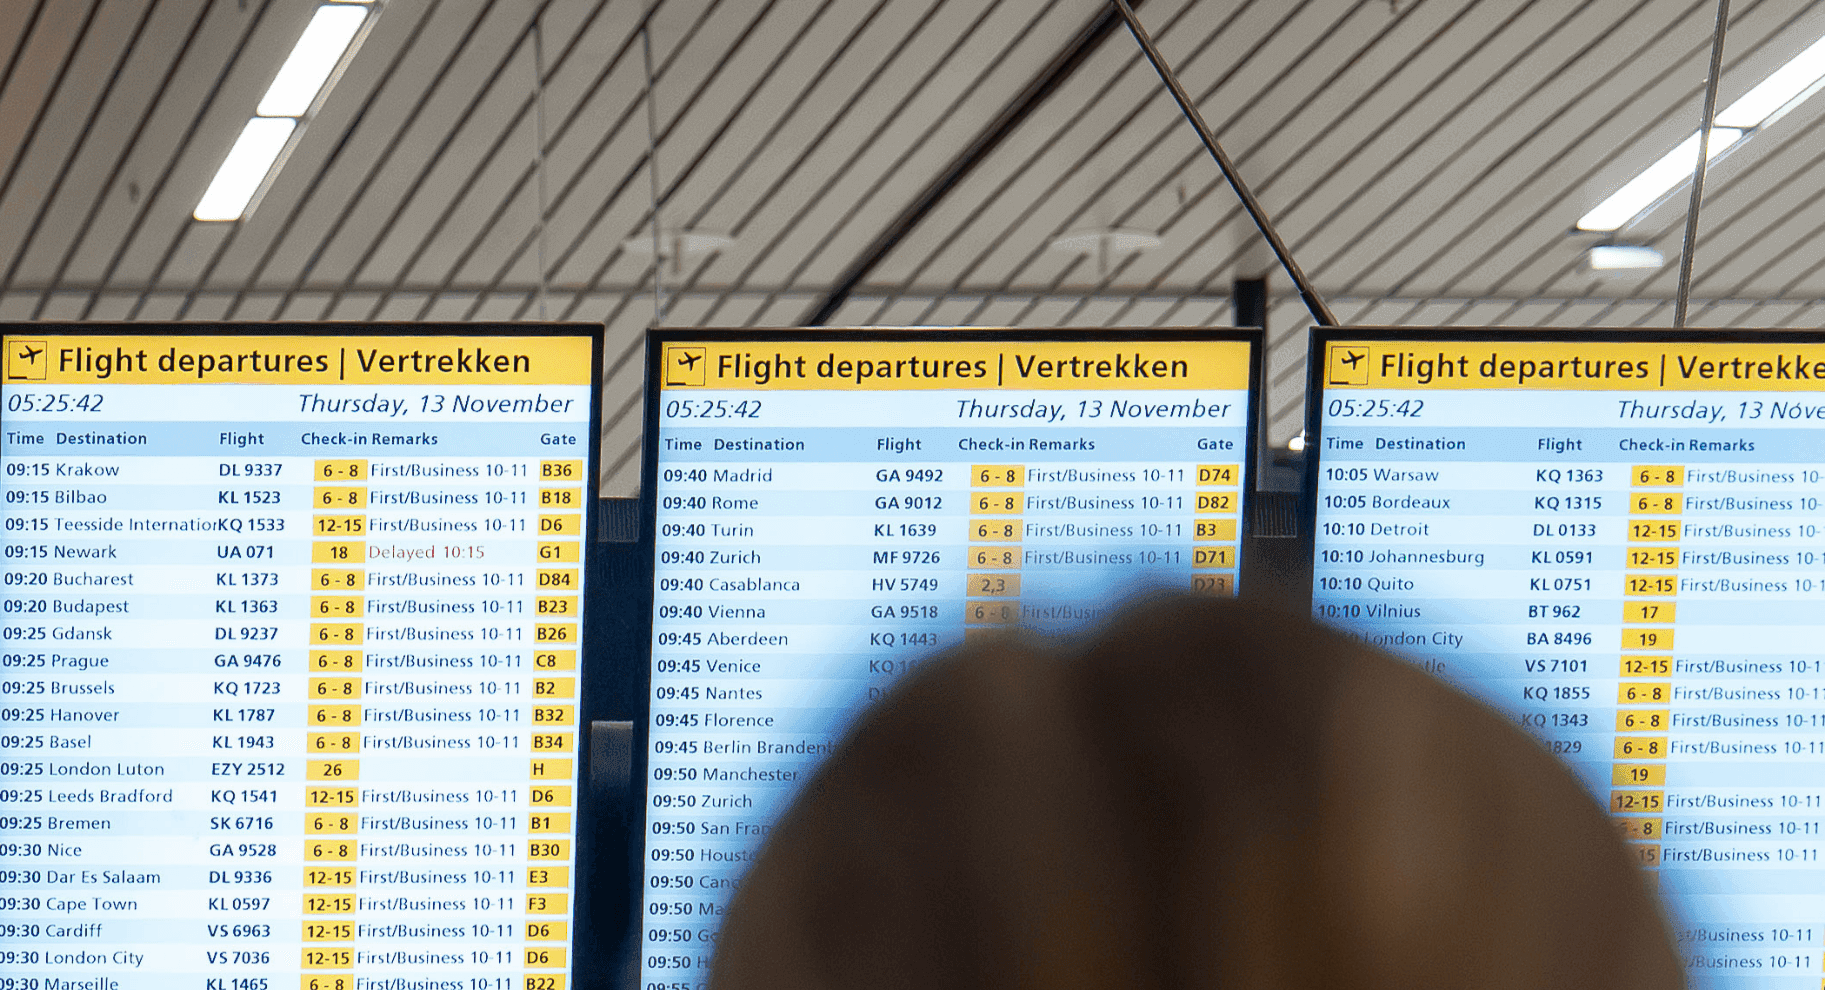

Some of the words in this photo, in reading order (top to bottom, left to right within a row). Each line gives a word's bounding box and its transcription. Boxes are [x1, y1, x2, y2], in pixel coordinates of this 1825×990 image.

[59, 346, 148, 379] Flight
[158, 347, 329, 379] departures
[356, 347, 530, 373] Vertrekken
[718, 352, 807, 385] Flight
[816, 352, 987, 385] departures
[1015, 353, 1188, 378] Vertrekken
[1381, 352, 1469, 385] Flight
[1479, 352, 1649, 385] departures
[8, 393, 104, 412] 05:25:42
[299, 392, 408, 418] Thursday,
[421, 394, 445, 413] 13
[452, 393, 575, 413] November
[666, 400, 762, 419] 05:25:42
[957, 398, 1066, 423] Thursday,
[1079, 400, 1103, 418] 13
[1109, 398, 1232, 418] November
[1328, 399, 1424, 418] 05:25:42
[1618, 399, 1726, 424] Thursday,
[1739, 401, 1764, 419] 13
[4, 544, 48, 559] 09:15
[54, 544, 117, 559] Newark
[217, 545, 242, 559] UA
[246, 545, 273, 559] 071
[330, 546, 348, 560] 18
[369, 544, 435, 563] Delayed
[444, 545, 485, 559] 10:15
[539, 545, 560, 559] G1
[660, 578, 704, 592] 09:40
[709, 577, 800, 591] Casablanca
[872, 578, 896, 592] HV
[900, 578, 938, 592] 5749
[981, 578, 1006, 594] 2,3
[1319, 604, 1361, 618] 10:10
[1366, 603, 1421, 618] Vilnius
[1528, 604, 1549, 618] BT
[1552, 605, 1581, 619] 962
[1641, 605, 1659, 619] 17
[655, 713, 699, 727] 09:45
[704, 712, 774, 727] Florence
[651, 821, 696, 835] 09:50
